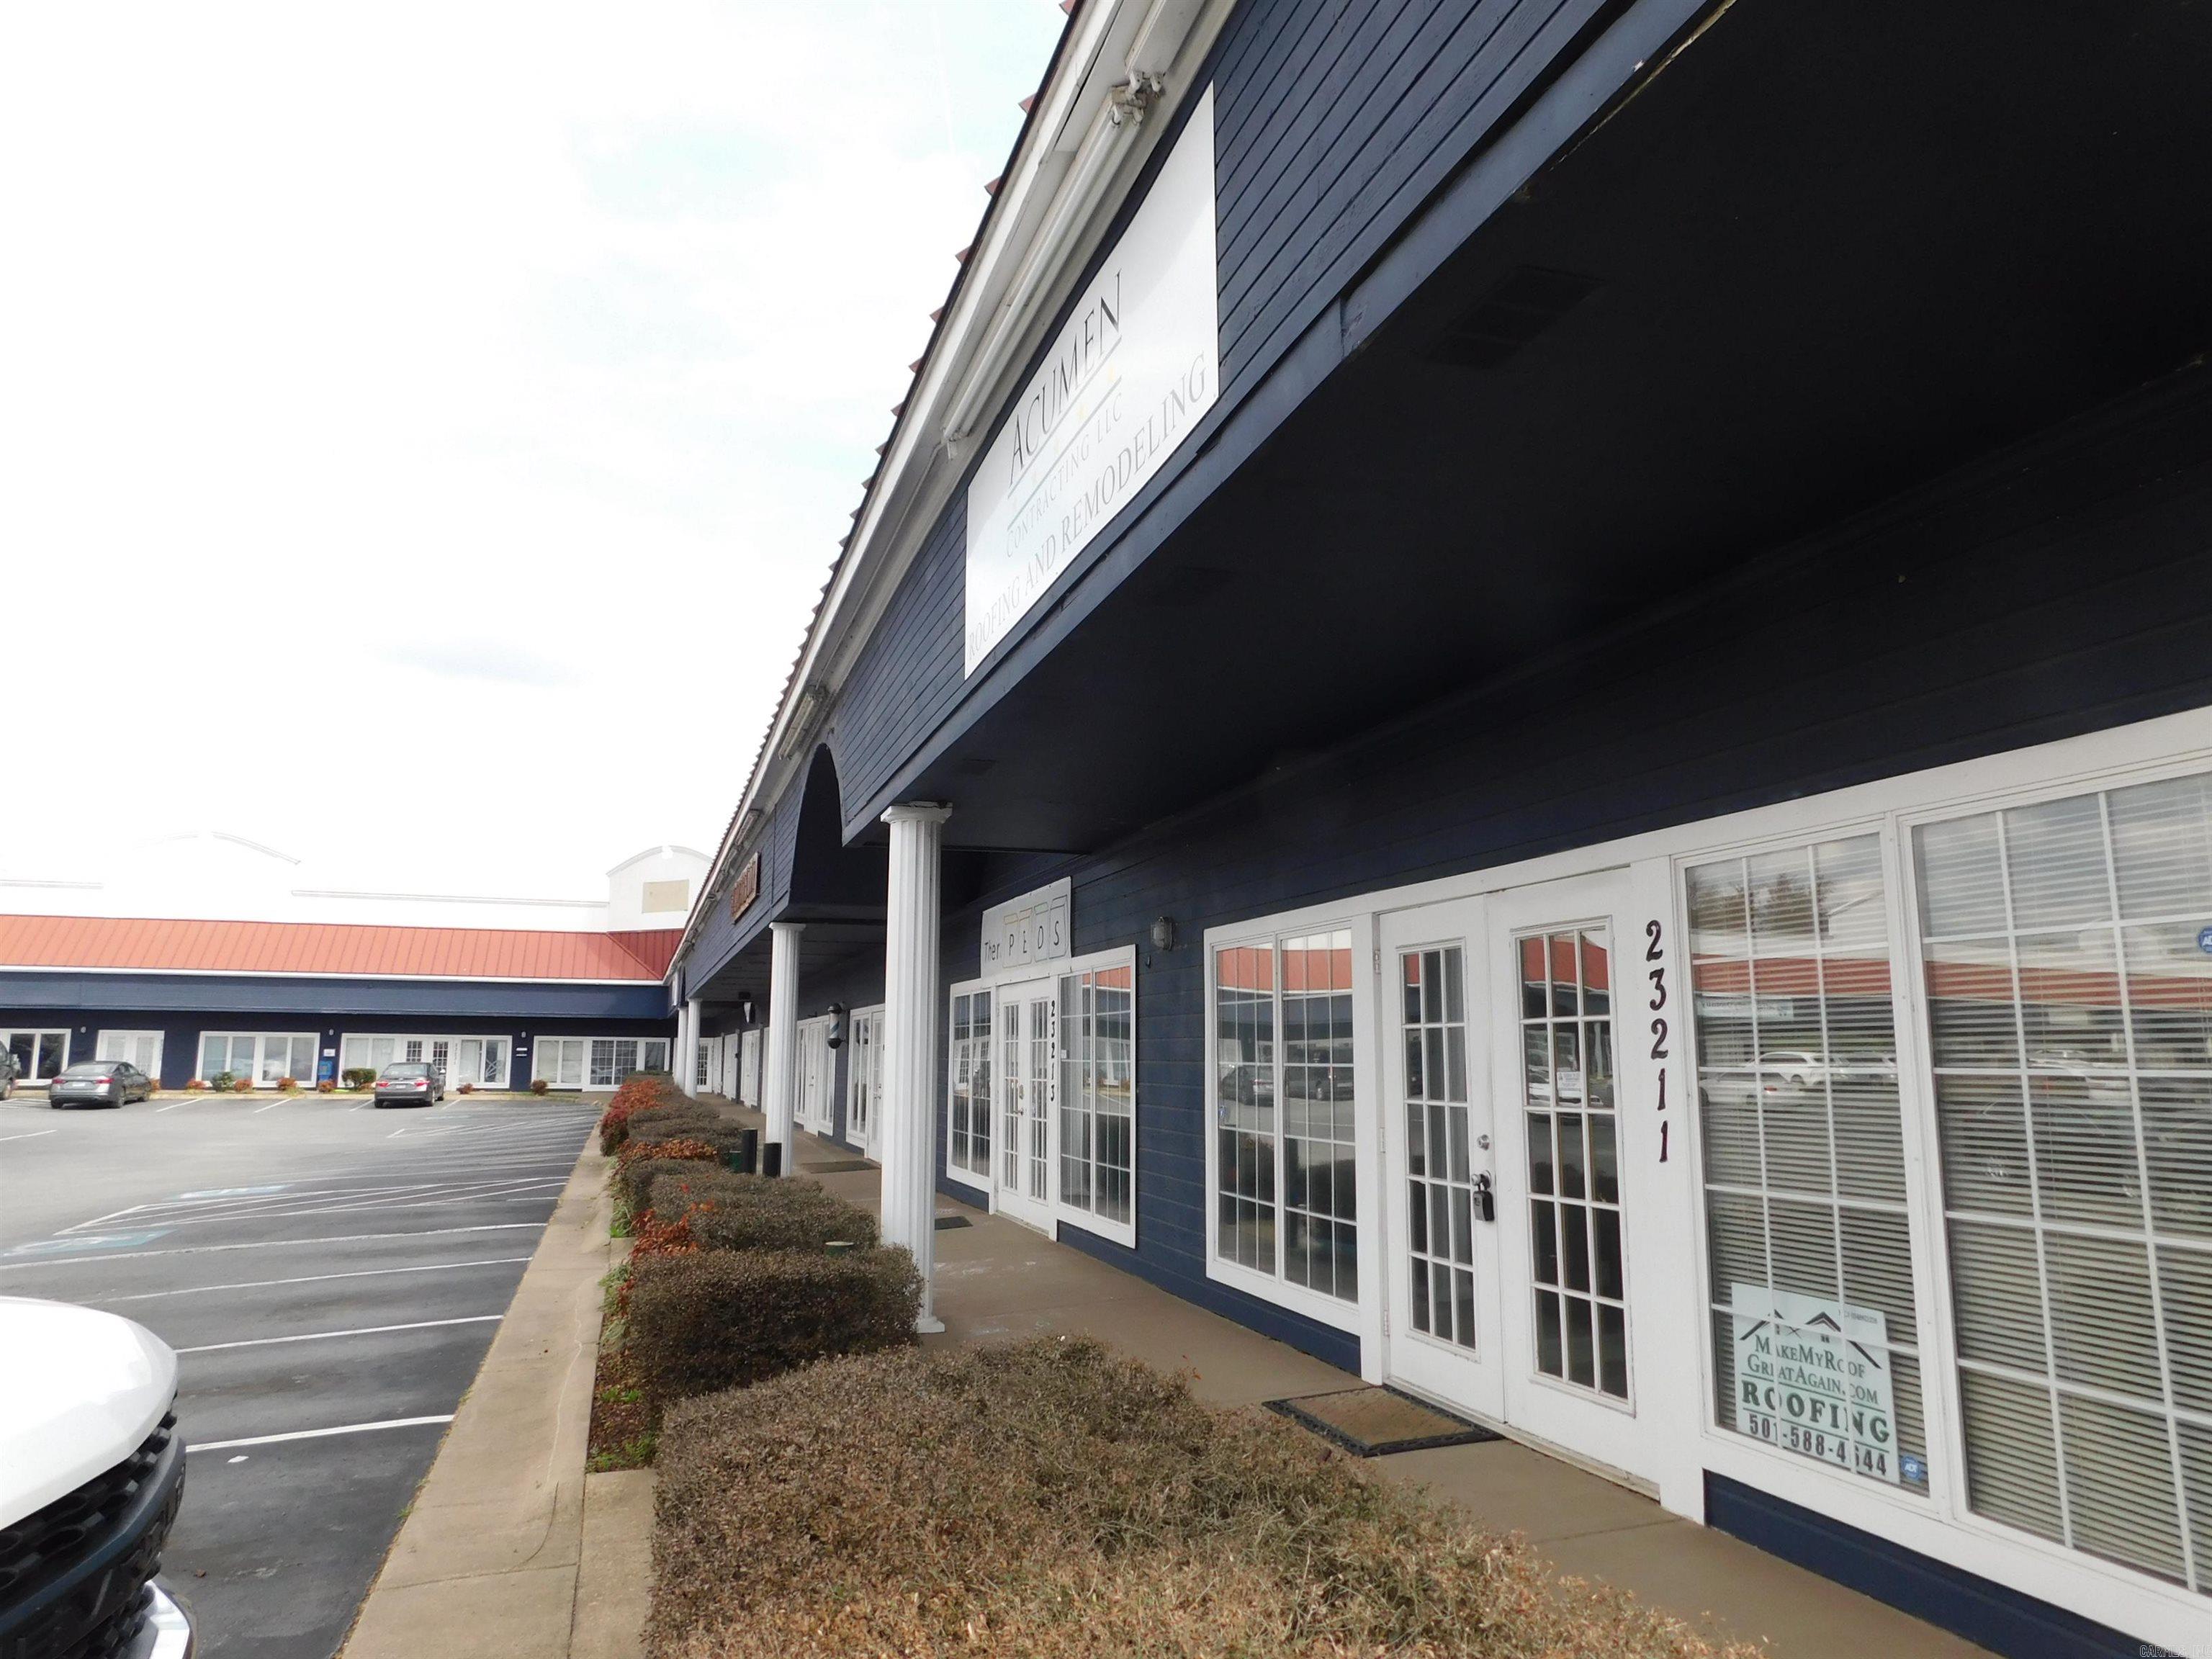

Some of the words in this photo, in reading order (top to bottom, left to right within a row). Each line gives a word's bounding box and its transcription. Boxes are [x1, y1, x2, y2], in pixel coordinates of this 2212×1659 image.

[1005, 433, 1090, 558] CONTRACTING
[1097, 392, 1123, 444] LLC
[1009, 271, 1123, 486] ACUMEN
[968, 577, 1020, 661] ROOFING
[1024, 533, 1057, 593] AND
[1061, 353, 1208, 555] REMODELING
[1646, 919, 1669, 1164] 23211
[1741, 1380, 1890, 1444] ROOFING
